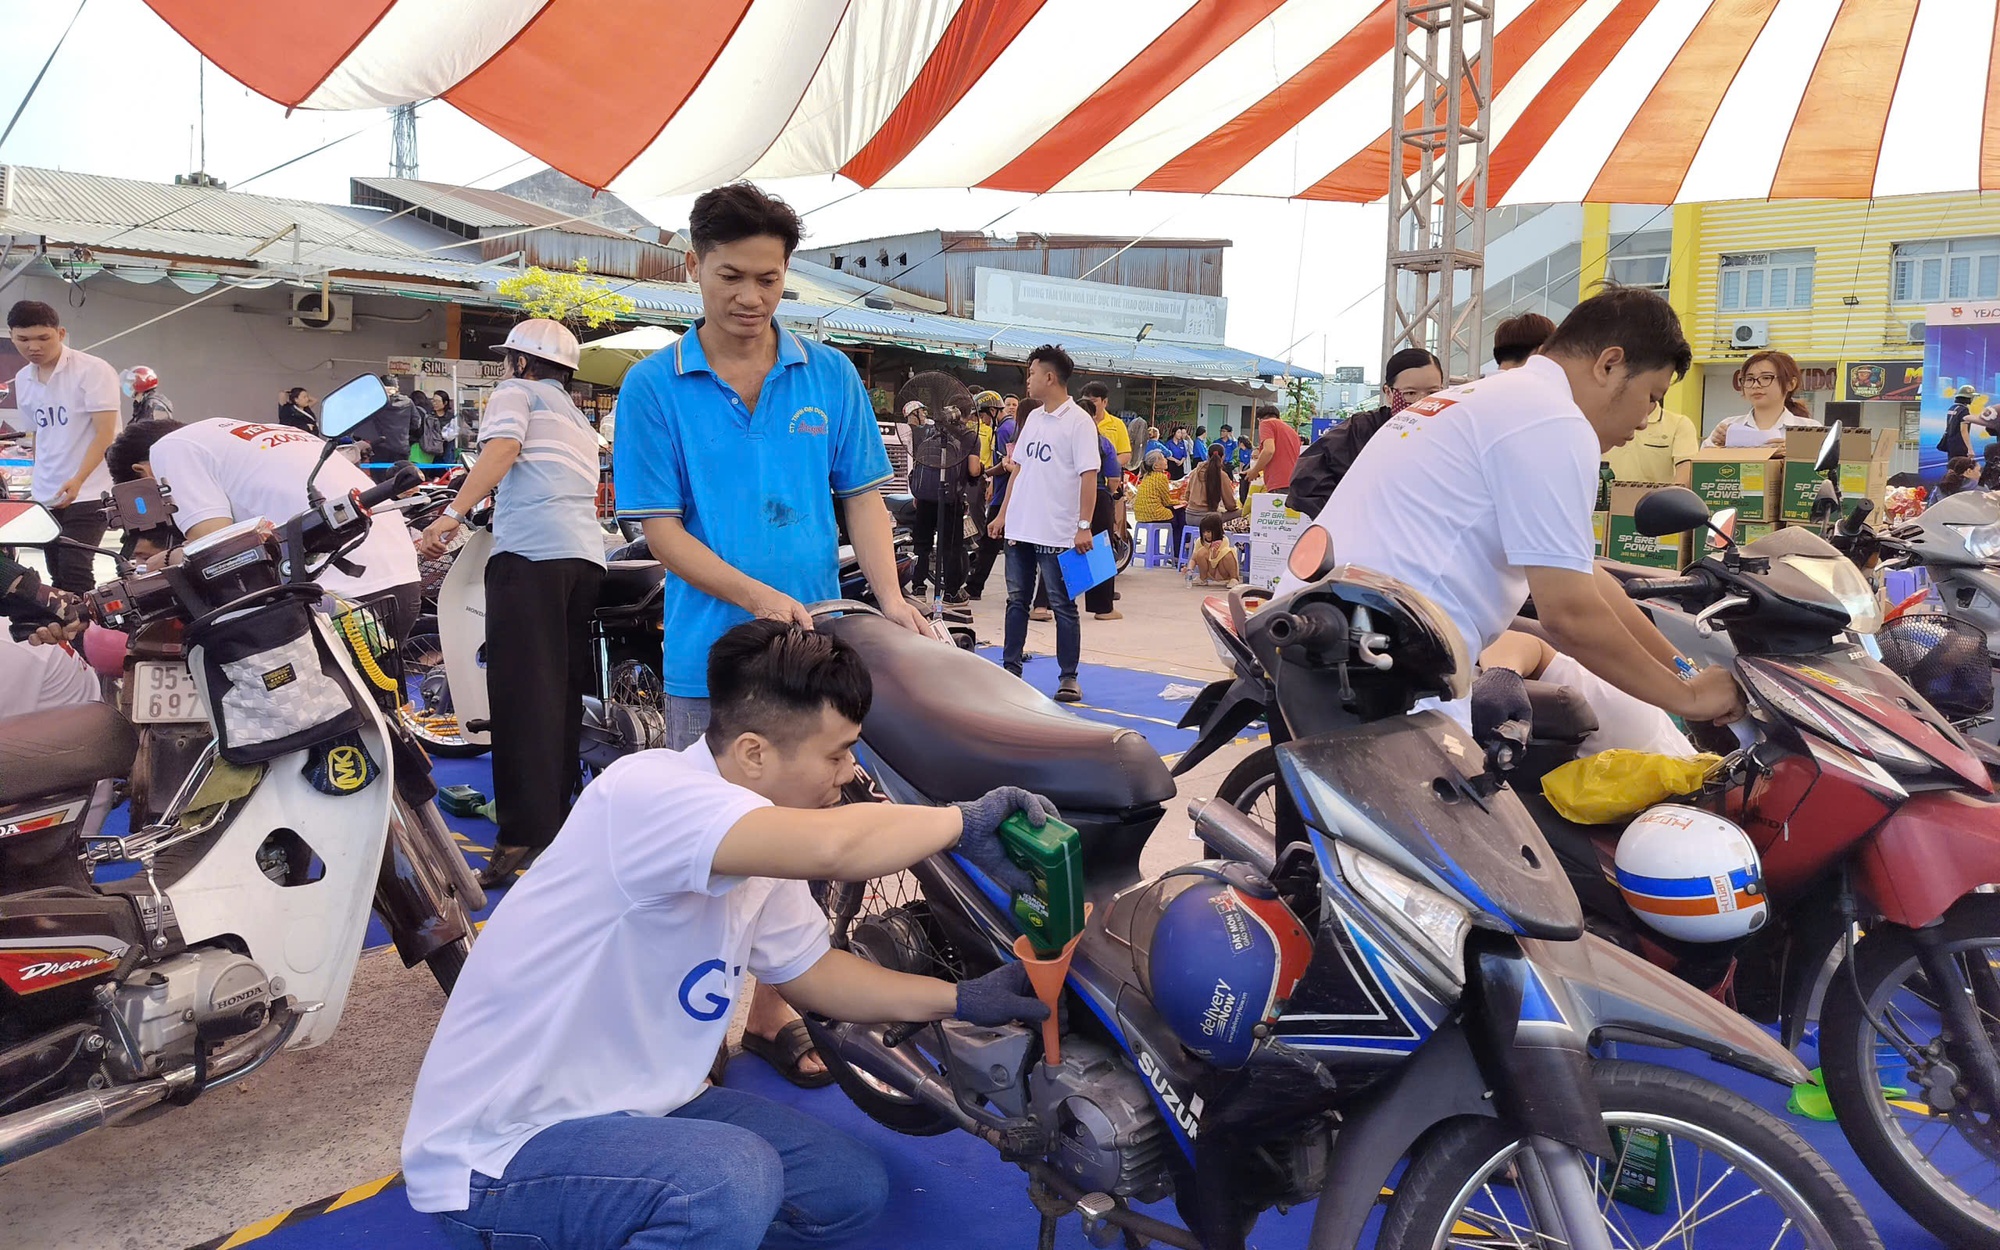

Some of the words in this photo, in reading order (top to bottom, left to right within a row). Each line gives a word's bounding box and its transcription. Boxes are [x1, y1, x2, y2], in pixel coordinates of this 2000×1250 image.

[424, 362, 447, 374] SINH
[34, 405, 68, 428] GIC
[1026, 441, 1052, 463] GIC
[1700, 482, 1716, 491] SP
[1706, 490, 1745, 500] POWER
[1793, 482, 1811, 492] SP
[1256, 518, 1285, 526] POWER
[1618, 534, 1632, 542] SP
[1623, 543, 1661, 553] POWER
[148, 693, 199, 718] 697
[19, 955, 107, 981] Dream
[216, 986, 262, 1011] HONDA
[1200, 978, 1232, 1036] delivery
[1218, 993, 1236, 1022] Now
